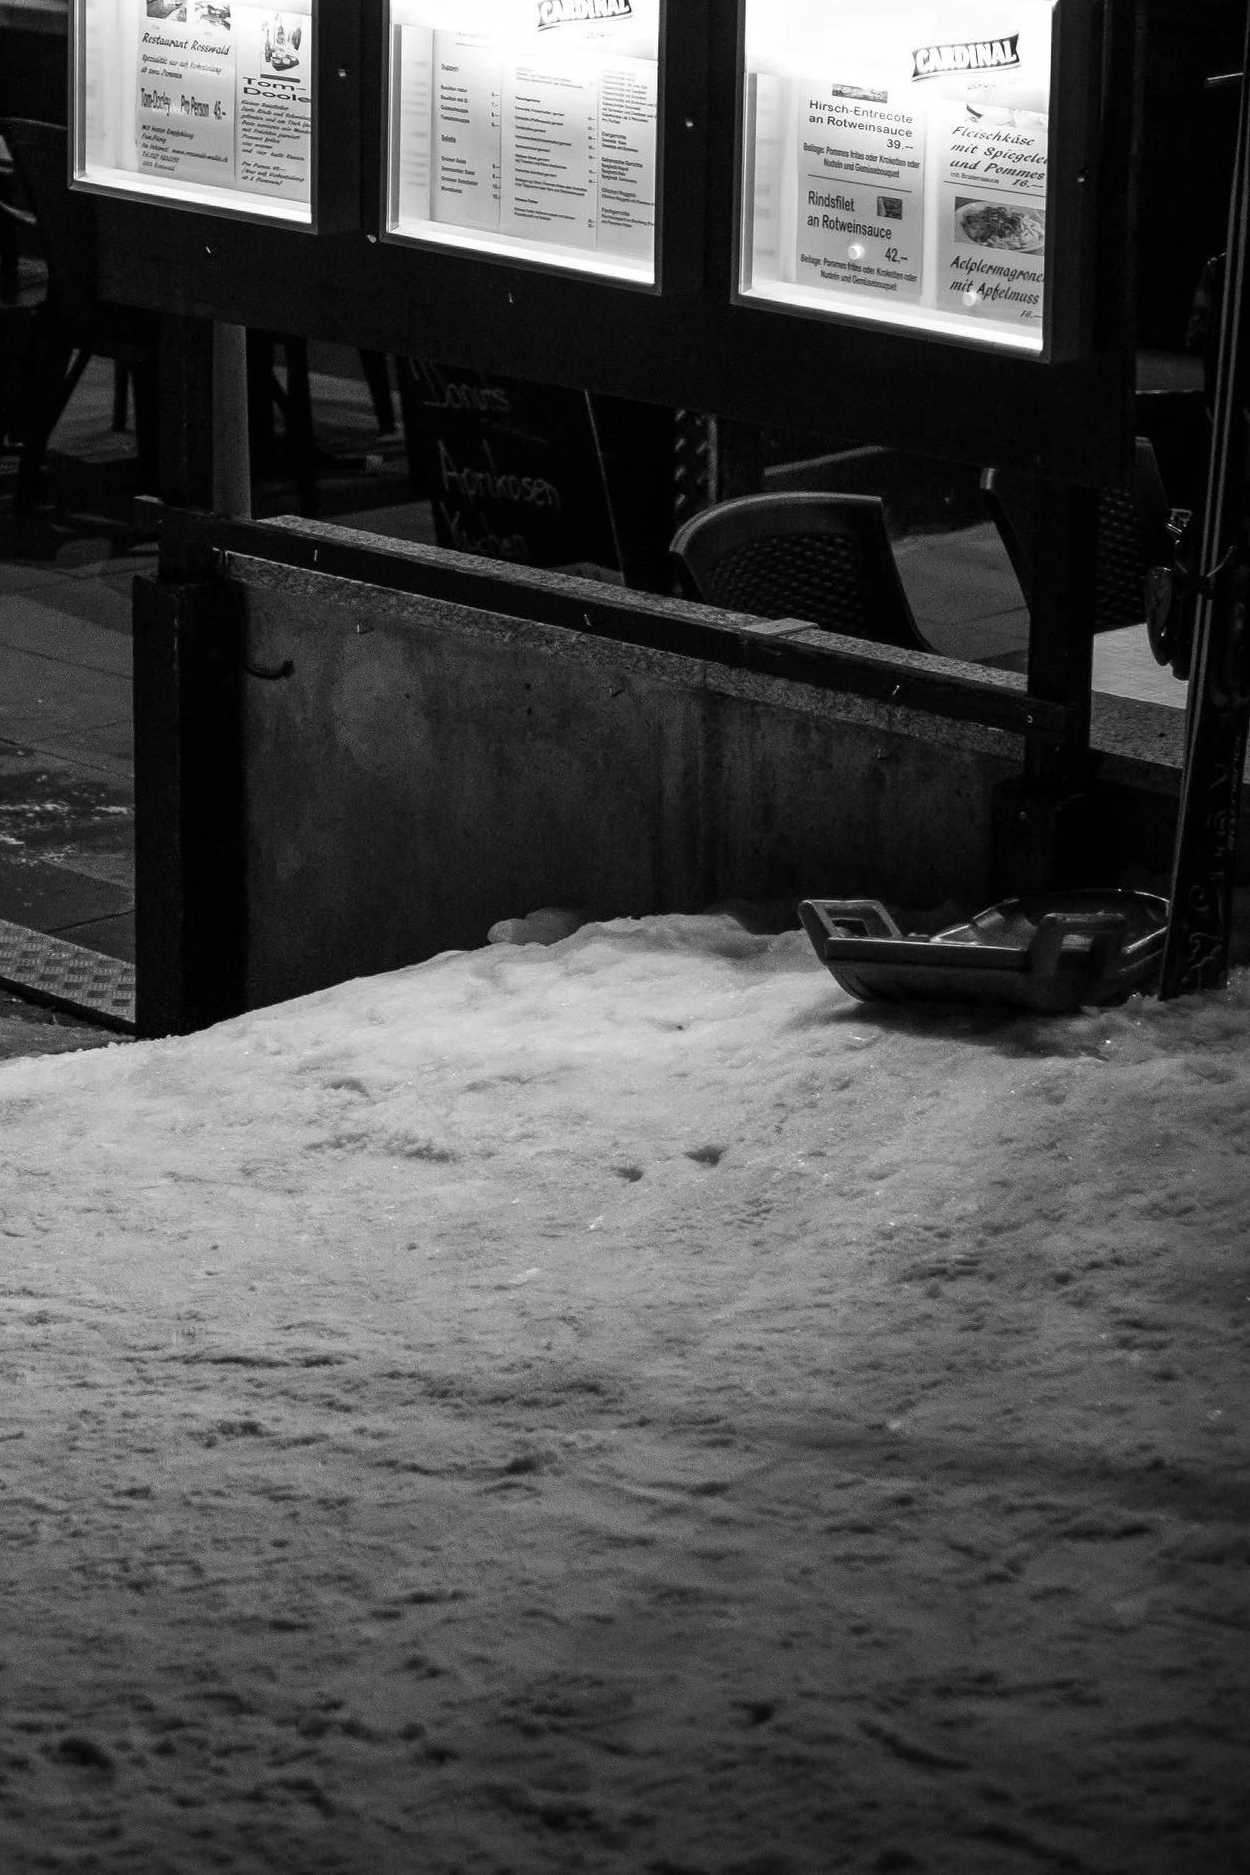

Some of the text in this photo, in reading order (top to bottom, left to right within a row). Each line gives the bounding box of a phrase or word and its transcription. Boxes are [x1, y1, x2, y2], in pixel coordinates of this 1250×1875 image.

[142, 32, 231, 55] Restaurant Rosswald
[914, 39, 1017, 74] CARDINAL
[242, 76, 306, 92] Tom-
[809, 115, 913, 138] an Rotweinsauce
[952, 126, 1035, 147] Fleischkäse
[826, 146, 849, 158] Pommes
[850, 150, 864, 160] frites
[865, 152, 878, 162] oder
[879, 154, 906, 167] Kroketten
[907, 159, 920, 169] oder
[950, 143, 978, 155] mit
[824, 158, 843, 169] Nudeln
[844, 162, 854, 171] und
[949, 158, 1045, 181] und Pommes
[961, 173, 1000, 185] Bratensauce
[808, 190, 855, 212] Rindsfilet
[807, 214, 892, 240] an Rotweinsauce
[821, 270, 840, 281] Nudeln
[841, 273, 851, 284] und
[823, 258, 847, 270] Pommes
[848, 262, 862, 273] frites
[863, 264, 875, 275] oder
[876, 267, 904, 281] Kroketten
[904, 273, 918, 283] oder
[950, 278, 1040, 305] mit Apfelmuss
